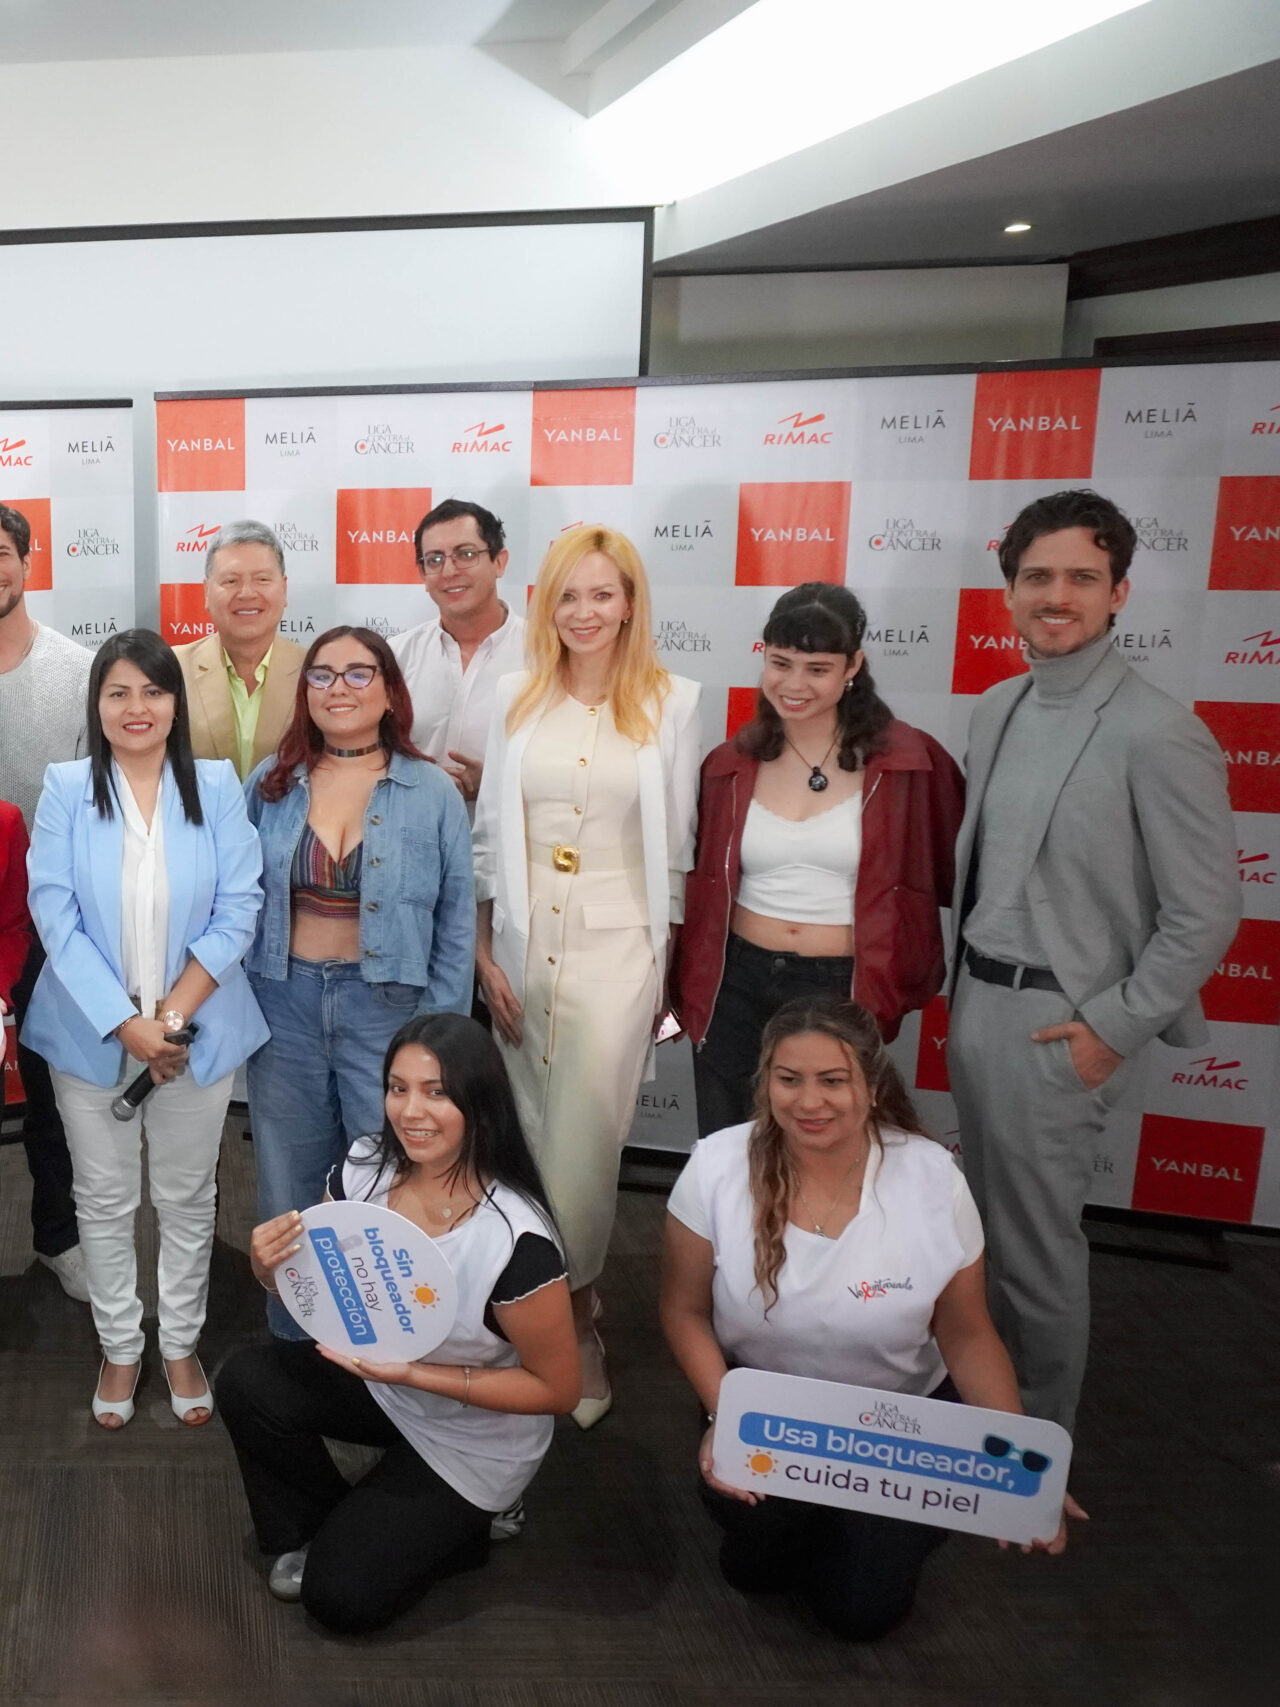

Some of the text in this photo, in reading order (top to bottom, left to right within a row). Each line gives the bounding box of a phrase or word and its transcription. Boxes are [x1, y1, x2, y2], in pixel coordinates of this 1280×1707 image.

[668, 416, 696, 427] LIGA
[987, 415, 1082, 432] YANBAL
[367, 424, 392, 434] LIGA
[544, 428, 622, 443] YANBAL
[1144, 430, 1174, 440] LIMA
[167, 437, 236, 452] YANBAL
[763, 431, 834, 445] RIMAC
[898, 435, 925, 444] LIMA
[451, 440, 513, 453] RIMAC
[885, 519, 915, 530] LIGA
[78, 529, 99, 538] LIGA
[751, 527, 836, 543] YANBAL
[1230, 526, 1280, 542] YAN
[176, 541, 208, 552] RIM
[283, 540, 319, 551] NCER
[670, 543, 695, 551] LIMA
[1135, 537, 1189, 552] NCER
[169, 622, 216, 635] YANB
[365, 616, 389, 627] LIGA
[660, 620, 687, 632] LIGA
[883, 648, 909, 657] LIMA
[1224, 651, 1280, 665] RIM
[1212, 963, 1273, 981] NBAL
[1171, 1072, 1249, 1091] RIMAC
[1151, 1156, 1244, 1182] YANBAL
[392, 1248, 414, 1278] Sin
[315, 1237, 368, 1337] protección
[351, 1256, 383, 1312] no hay
[364, 1227, 415, 1334] bloqueador
[762, 1419, 1015, 1490] Usa bloqueador,
[785, 1461, 980, 1516] cuida tu piel
